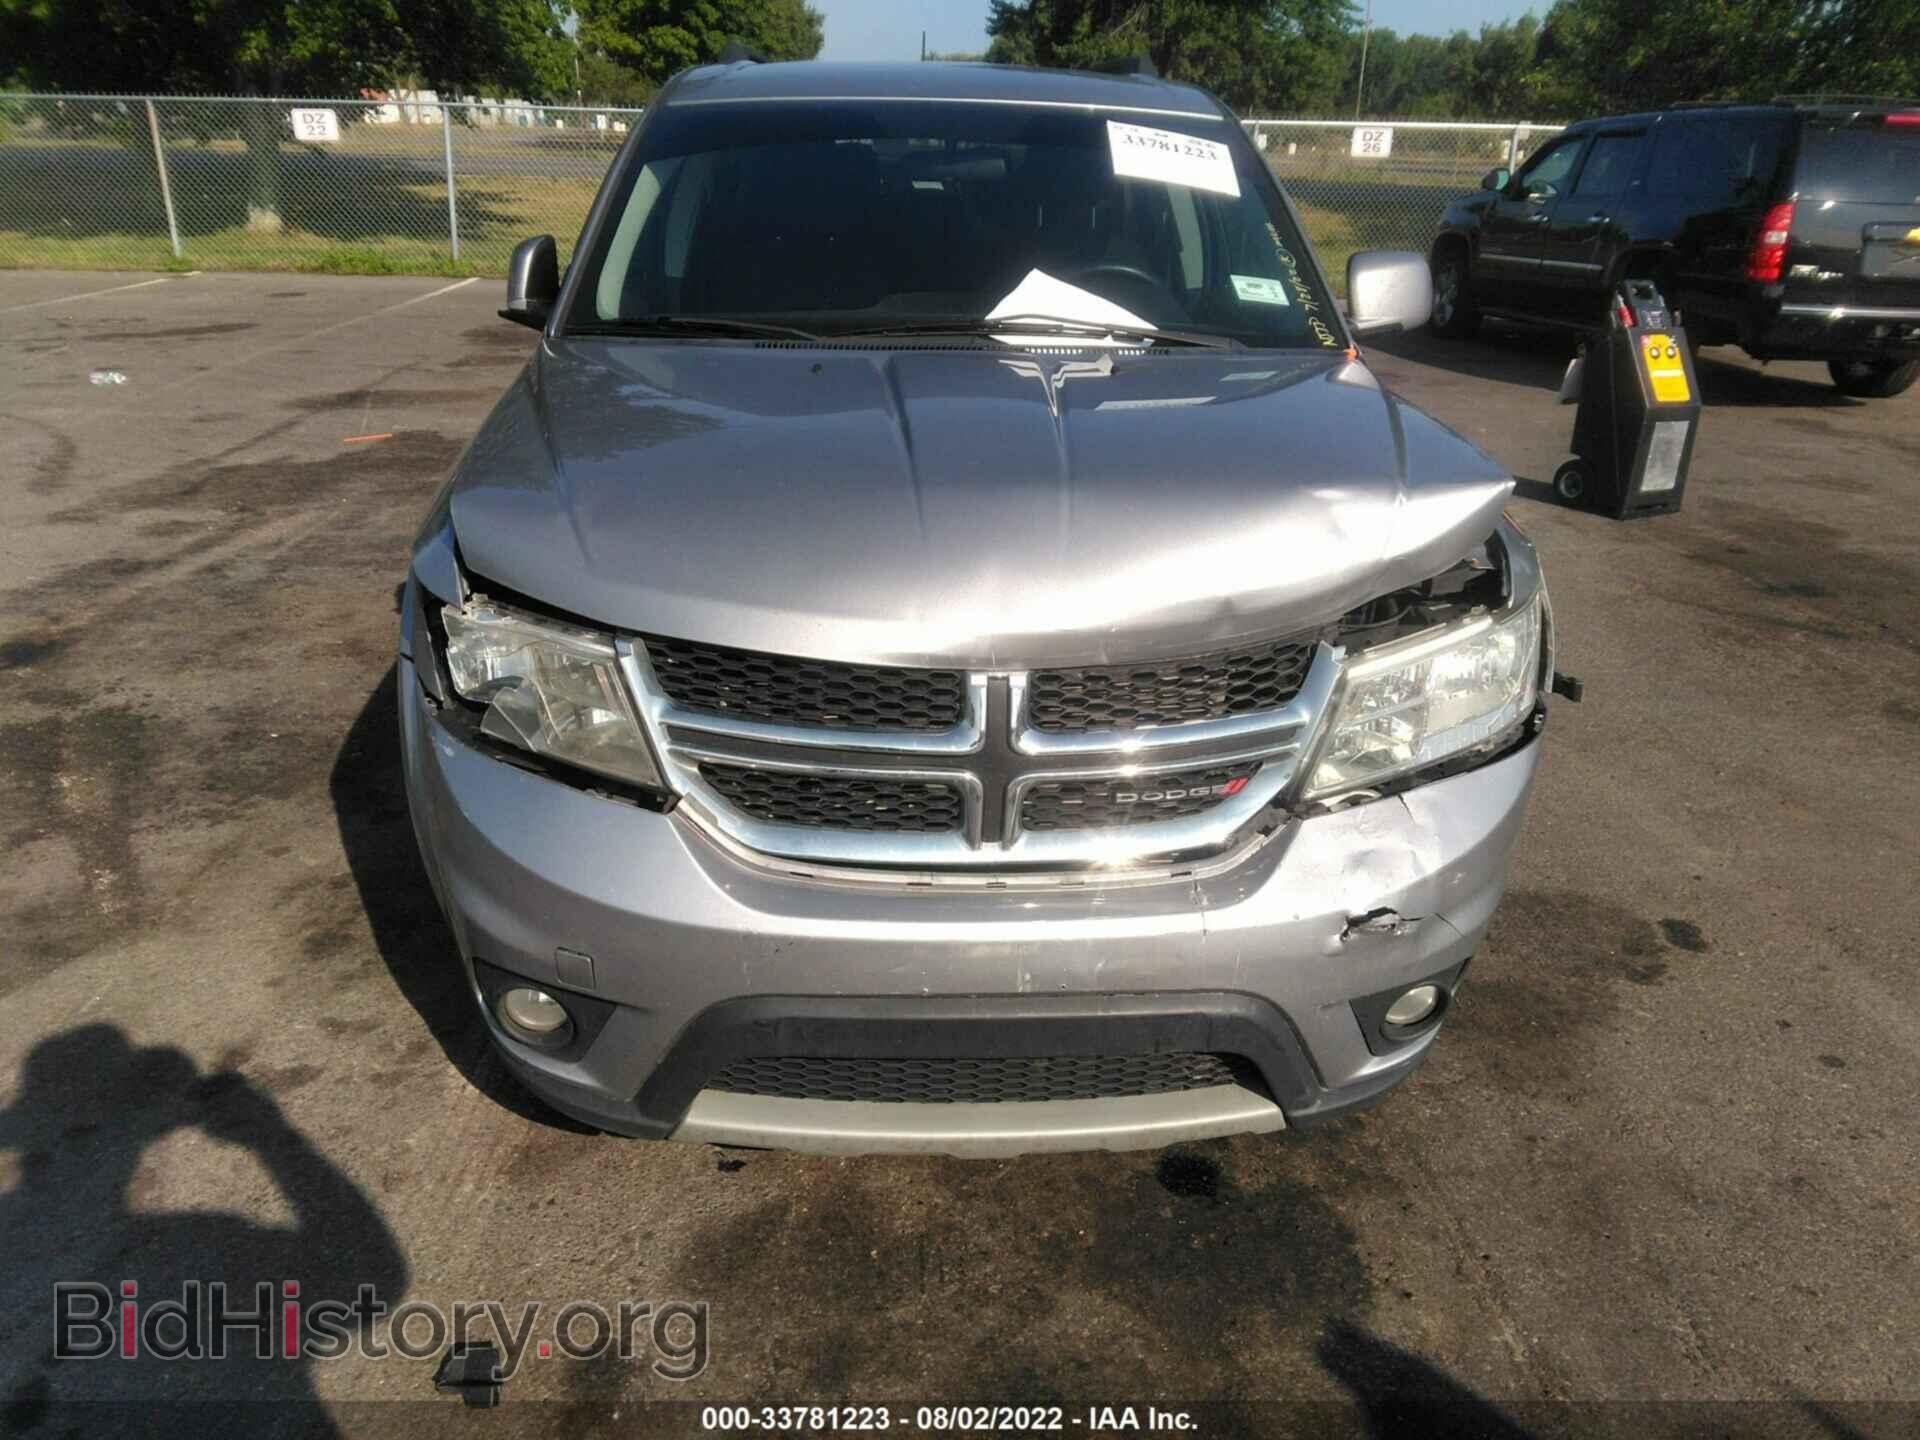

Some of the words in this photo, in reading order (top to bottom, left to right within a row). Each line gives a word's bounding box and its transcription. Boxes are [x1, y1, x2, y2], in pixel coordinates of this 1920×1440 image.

[302, 113, 326, 124] DZ
[1362, 131, 1385, 142] DZ
[1122, 134, 1218, 161] 33781223
